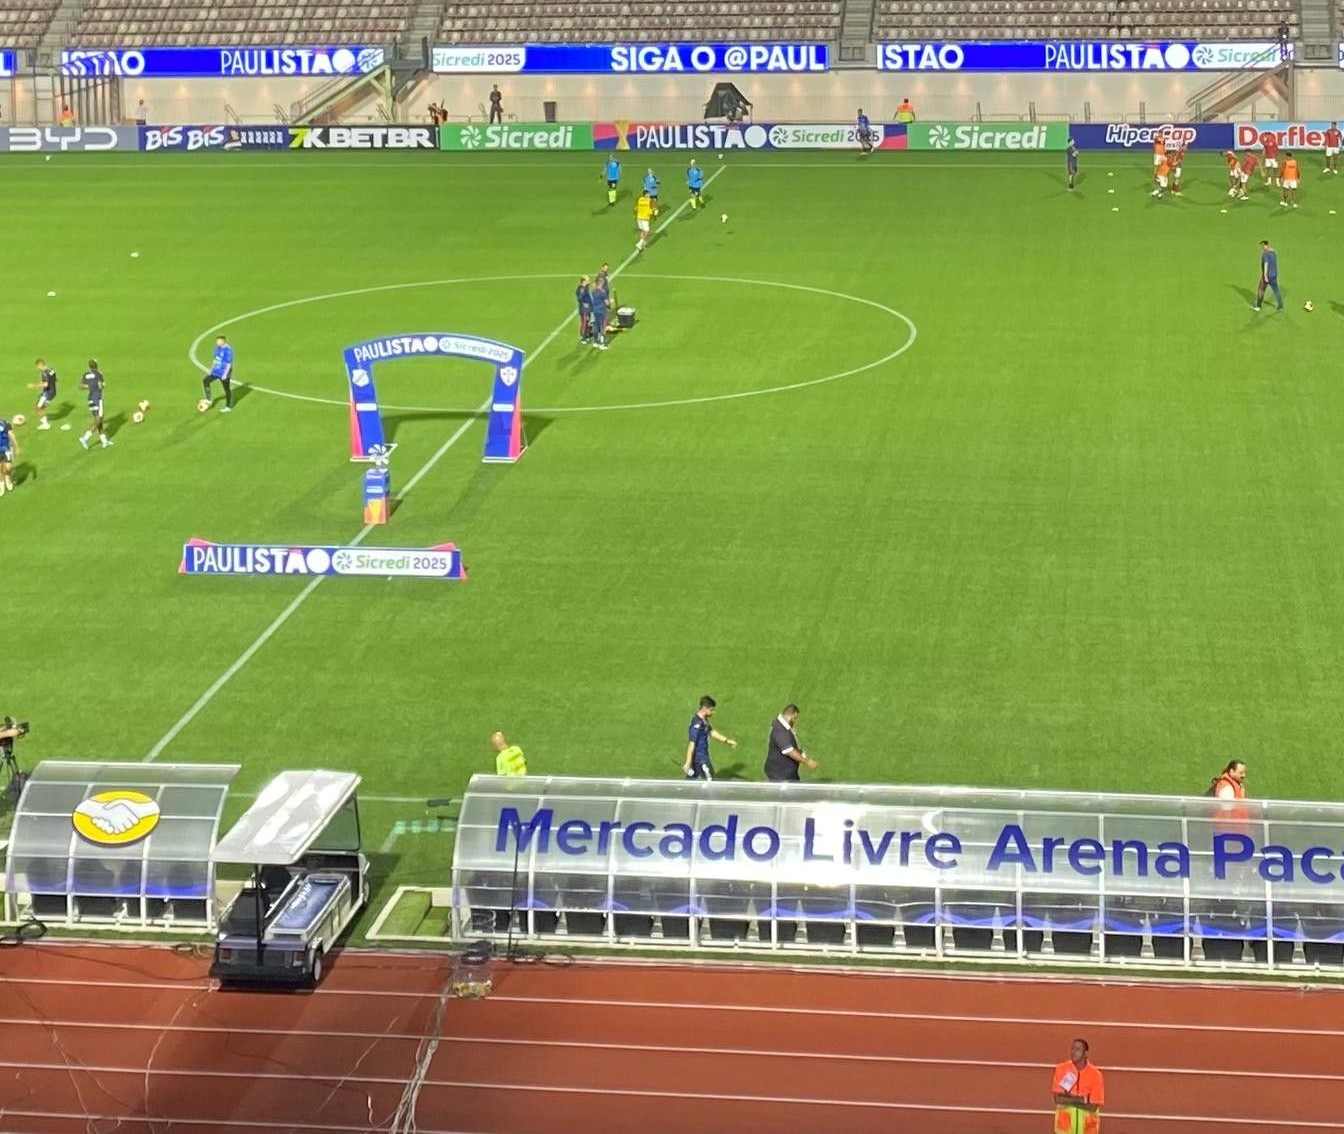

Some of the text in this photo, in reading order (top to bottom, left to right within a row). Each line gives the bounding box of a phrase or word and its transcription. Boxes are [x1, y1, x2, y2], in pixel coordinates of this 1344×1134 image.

[432, 52, 521, 67] Sicredi 2025
[610, 46, 825, 72] SIGA O @PAUL
[876, 43, 965, 70] ISTAO
[1217, 48, 1276, 63] Sicredi
[9, 127, 118, 150] BYD
[484, 124, 574, 149] Sicredi
[792, 129, 845, 143] Sicredi
[956, 124, 1048, 149] Sicredi
[356, 554, 412, 570] Sicredi
[413, 556, 448, 571] 2025
[495, 807, 781, 863] Mercado
[803, 817, 963, 870] Livre
[987, 824, 1191, 880] Arena
